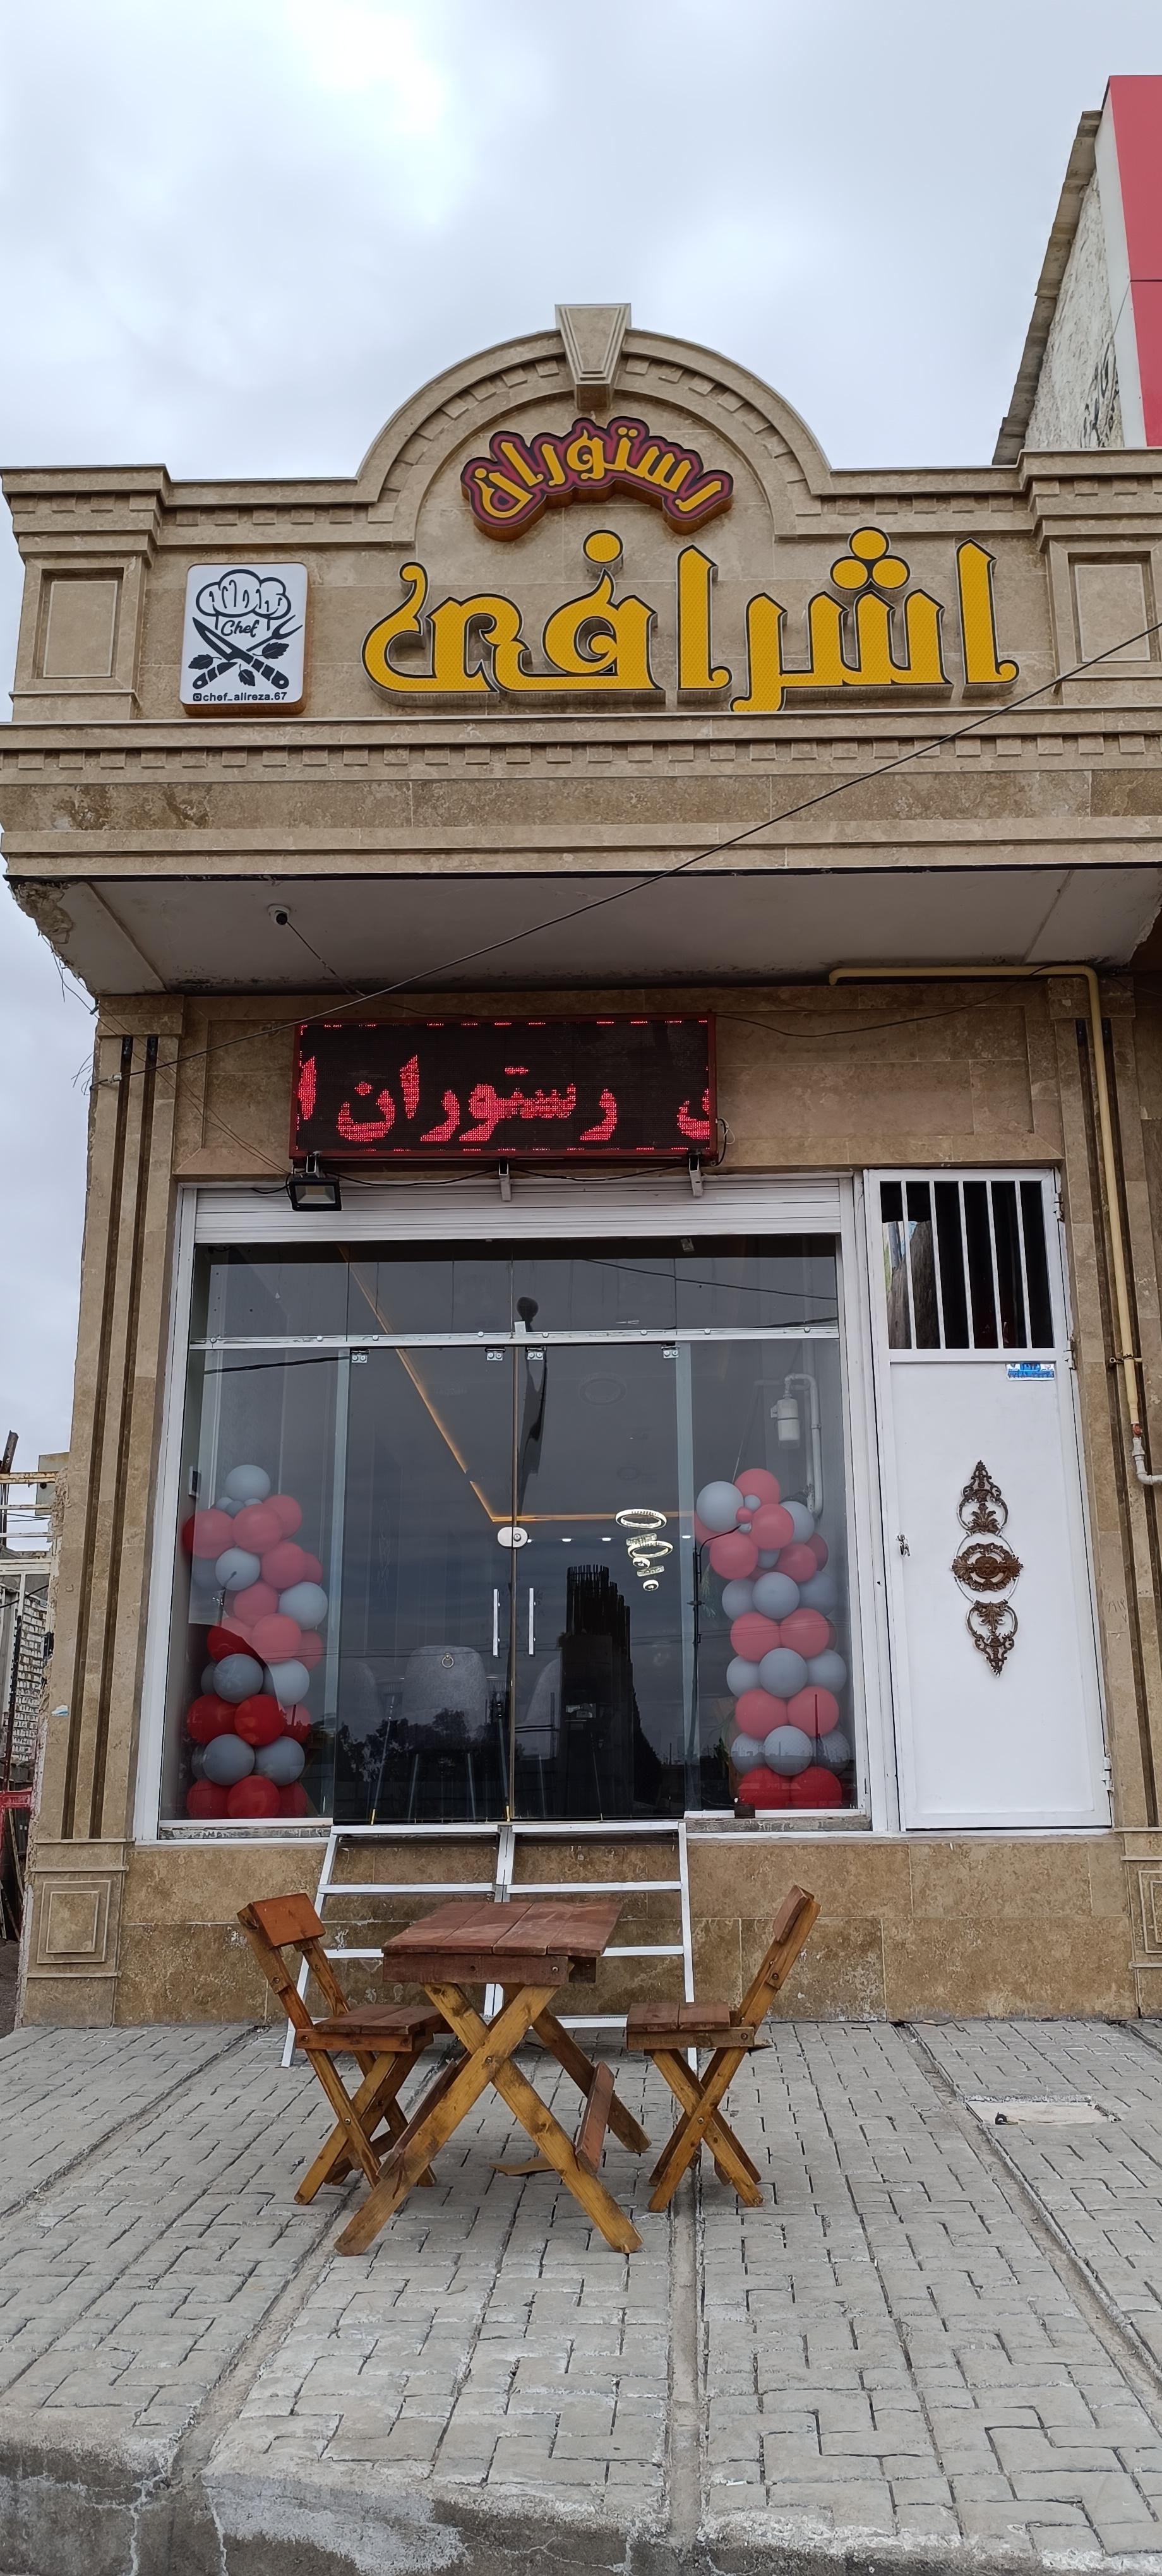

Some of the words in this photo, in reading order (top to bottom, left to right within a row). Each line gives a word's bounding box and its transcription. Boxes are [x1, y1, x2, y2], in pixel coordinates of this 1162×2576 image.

[474, 426, 722, 518] رستوران
[220, 619, 260, 638] Chef
[362, 527, 1019, 712] اشرافی
[336, 1054, 618, 1142] رستوران
